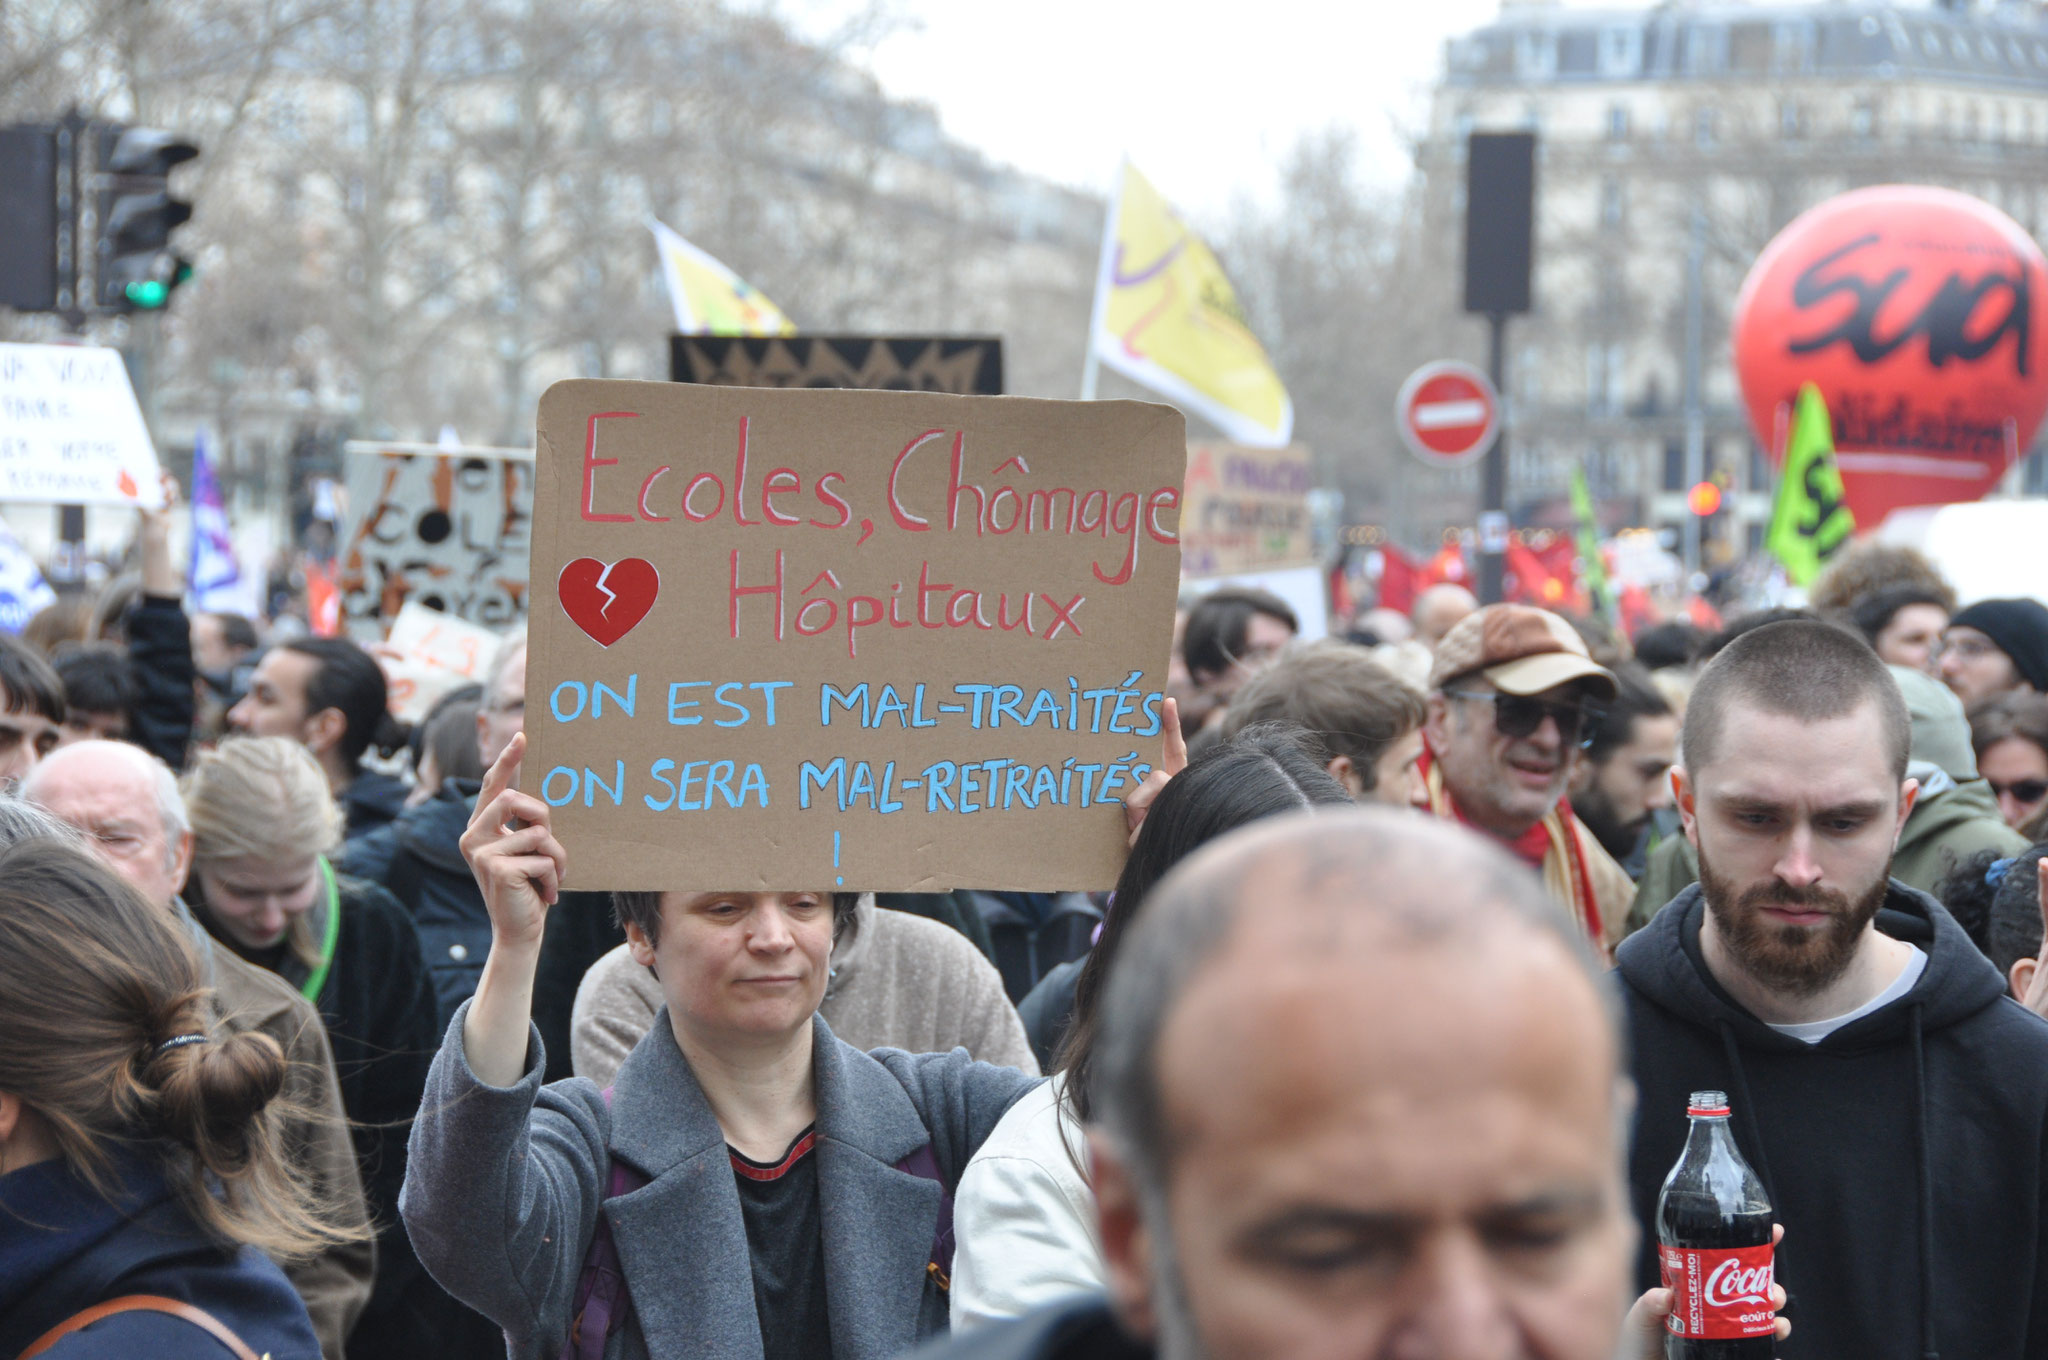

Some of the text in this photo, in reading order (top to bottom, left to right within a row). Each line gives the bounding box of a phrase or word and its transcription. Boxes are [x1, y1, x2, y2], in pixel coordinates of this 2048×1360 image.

[581, 412, 1181, 586] Ecoles, Chômage
[729, 549, 1087, 660] Hôpitaux
[549, 673, 638, 723] ON
[667, 680, 795, 728] EST
[541, 759, 625, 808] ON
[643, 757, 771, 812] SERA
[833, 830, 844, 887] !
[1687, 1253, 1700, 1334] RECYCLEZ-MOI
